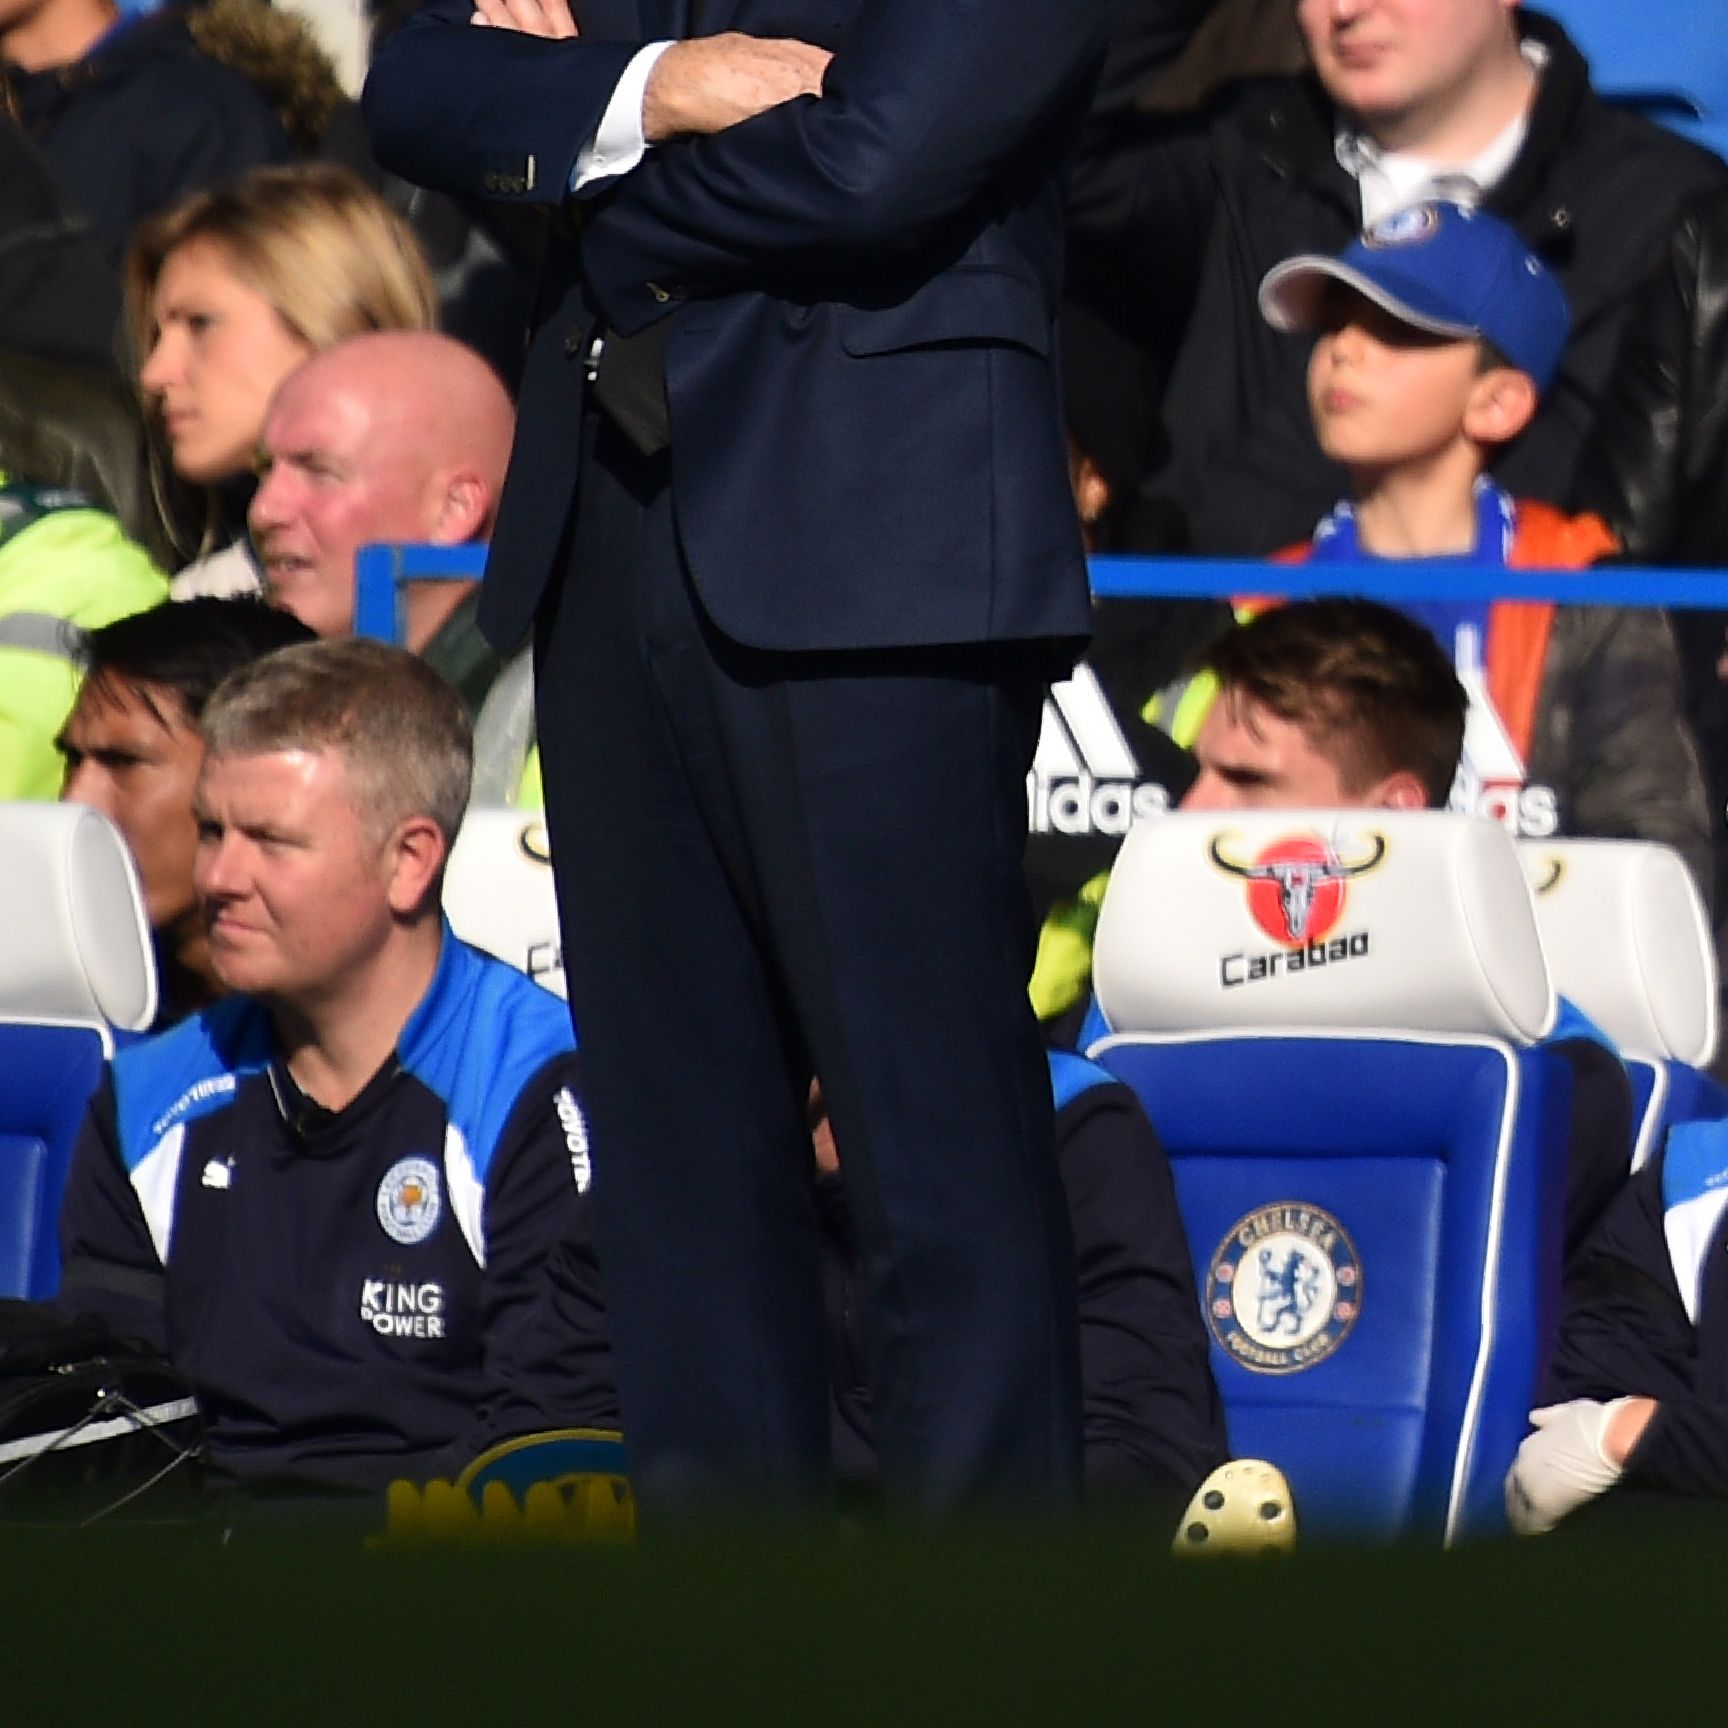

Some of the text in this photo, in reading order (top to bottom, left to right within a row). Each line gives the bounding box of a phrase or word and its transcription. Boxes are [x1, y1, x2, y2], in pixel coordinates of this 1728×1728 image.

[1026, 772, 1167, 835] idas
[1221, 931, 1369, 987] Carabao
[1239, 1207, 1336, 1251] CHELSEA
[362, 1278, 441, 1314] KING
[360, 1305, 444, 1339] POWER
